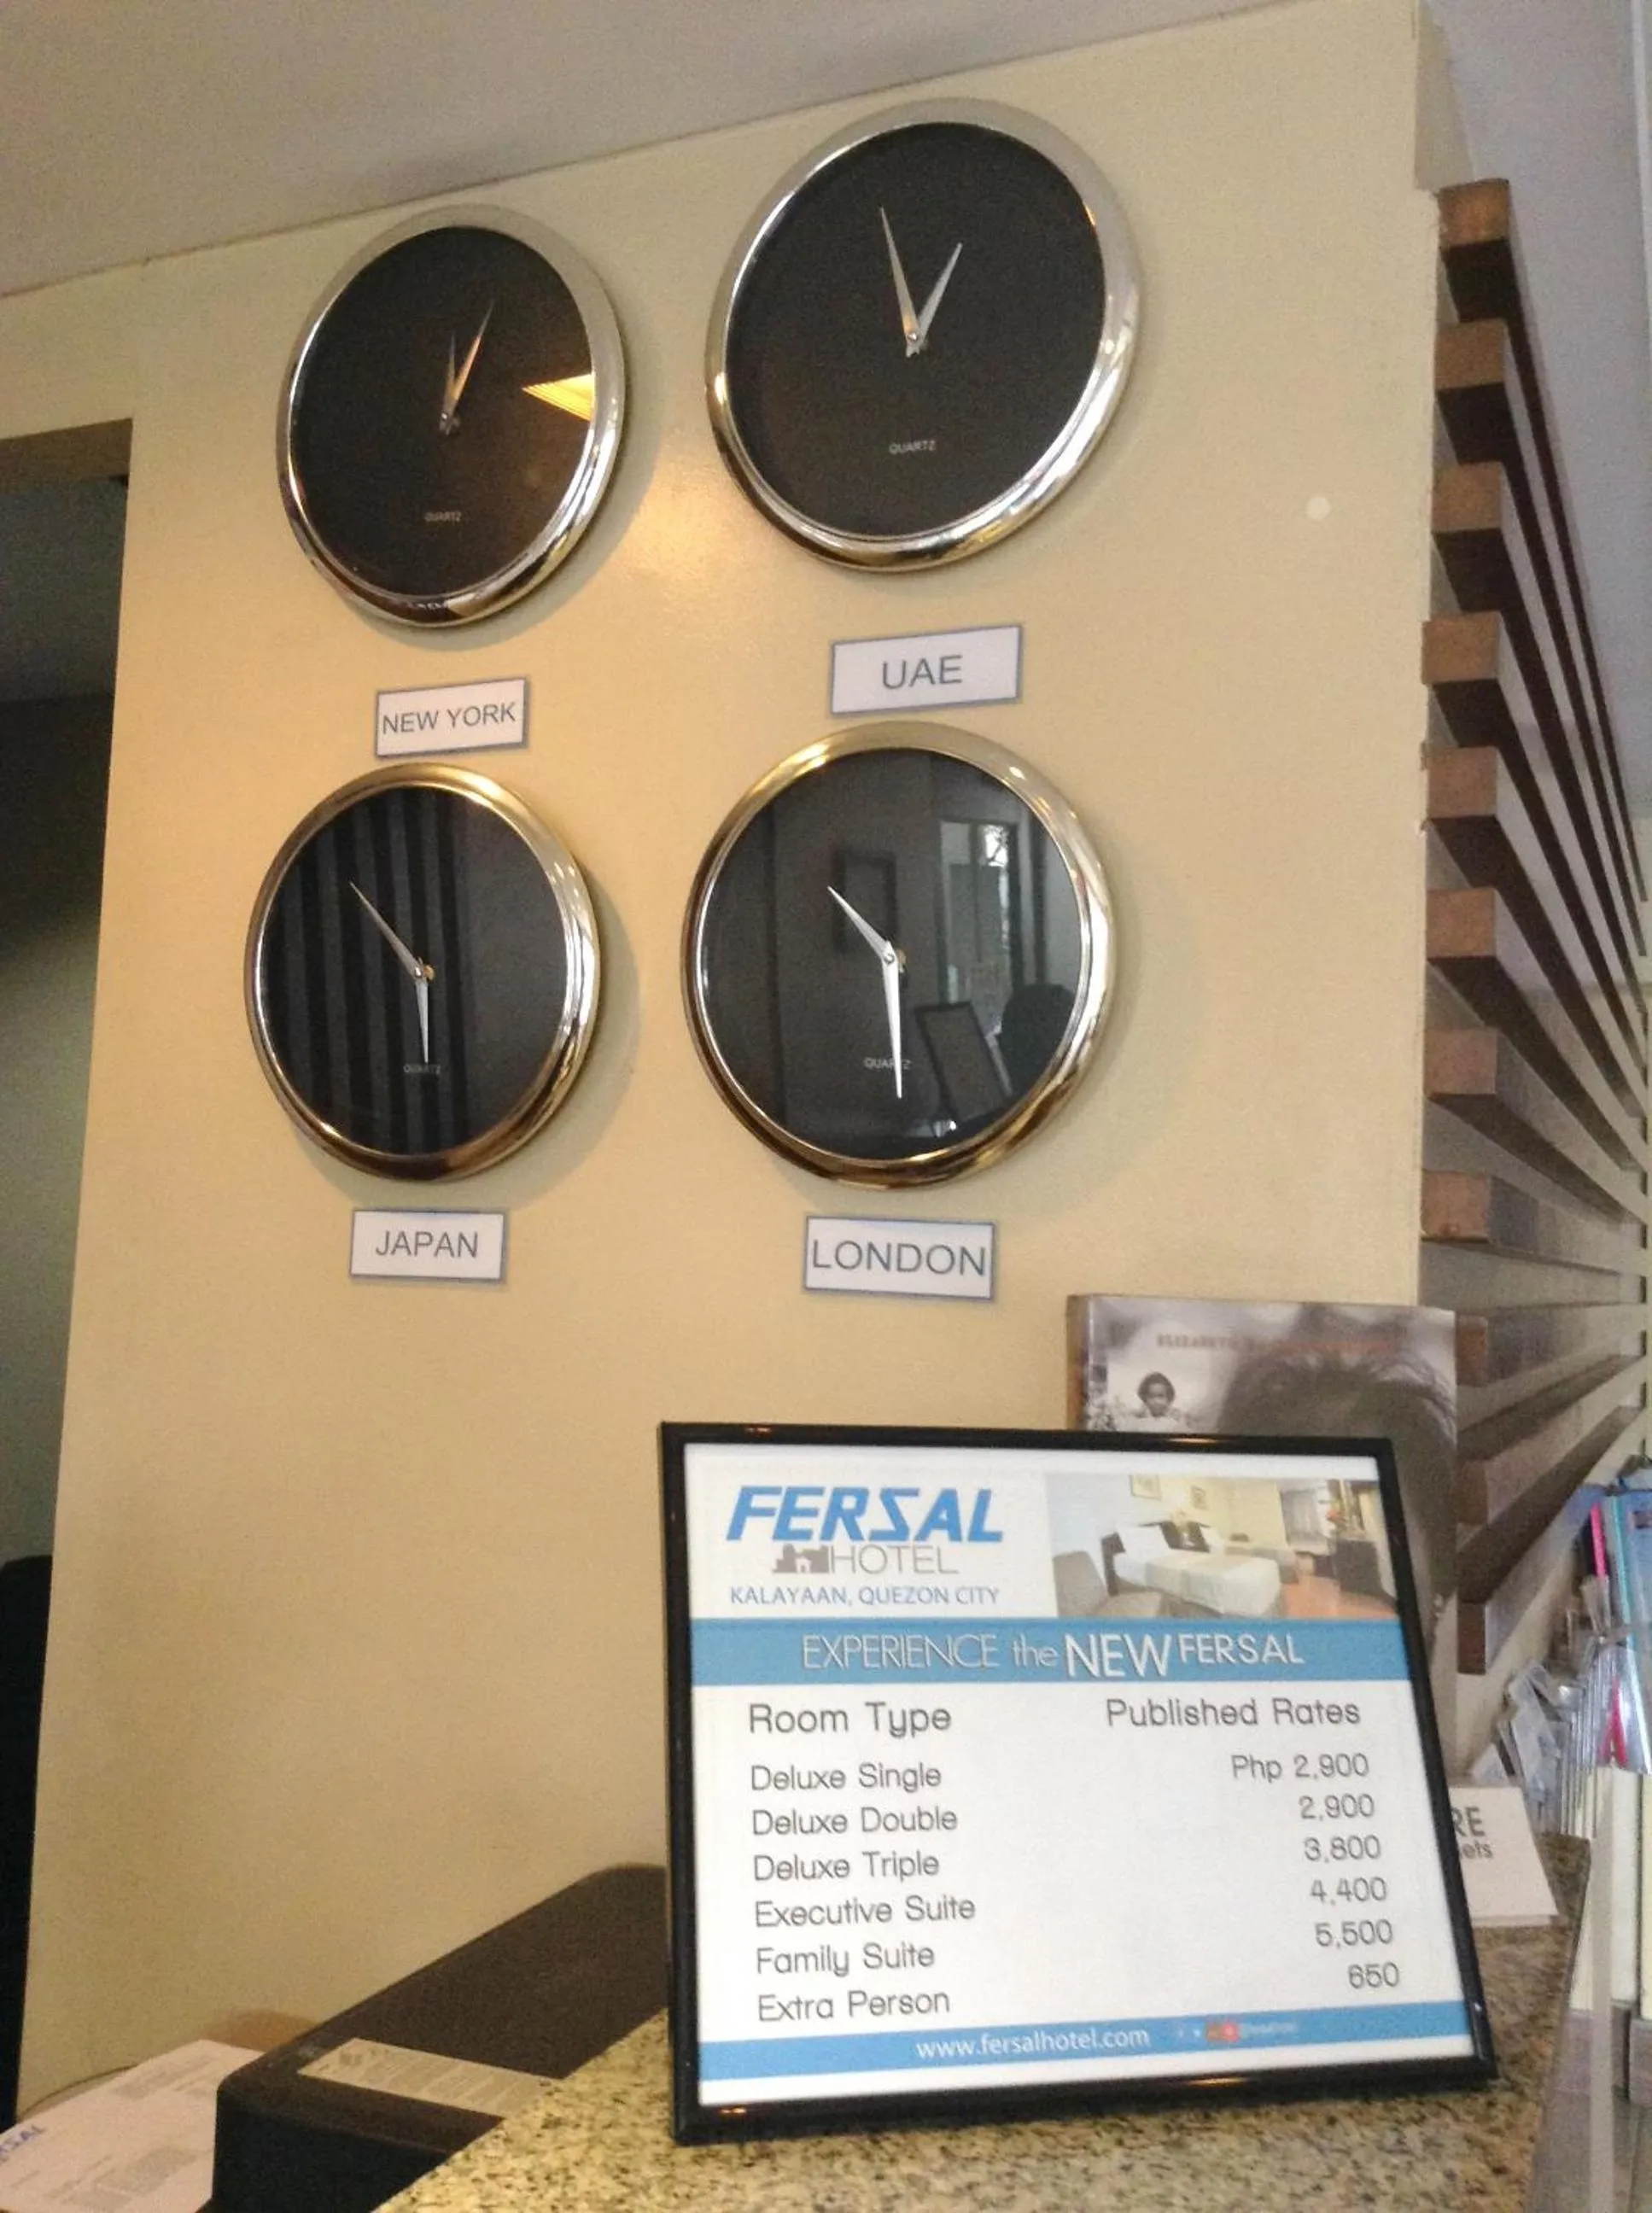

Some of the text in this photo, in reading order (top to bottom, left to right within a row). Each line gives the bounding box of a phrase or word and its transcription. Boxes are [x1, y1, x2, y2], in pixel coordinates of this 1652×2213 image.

[889, 440, 936, 455] QUARTZ
[881, 654, 963, 690] UAE
[382, 701, 517, 735] NEW YORK
[375, 1230, 478, 1258] JAPAN
[813, 1239, 985, 1276] LONDON
[726, 1486, 1004, 1544] FERSAL
[829, 1545, 960, 1575] HOTEL
[730, 1585, 1001, 1607] KALAYAAN, QUEZON CITY
[802, 1633, 1306, 1678] EXPERIENCE the NEW FERSAL
[749, 1702, 952, 1738] Room Type
[1106, 1697, 1362, 1726] Published Rates
[751, 1761, 943, 1794] Deluxe Single
[1231, 1754, 1282, 1783] Php
[752, 1806, 959, 1836] Deluxe Double
[754, 1849, 941, 1883] Deluxe Triple
[756, 1895, 977, 1928] Executive Suite
[756, 1941, 937, 1977] Family Suite
[1347, 1961, 1400, 1990] 650
[758, 1989, 952, 2022] Extra Person
[915, 2027, 1151, 2060] www.fersalhotel.com
